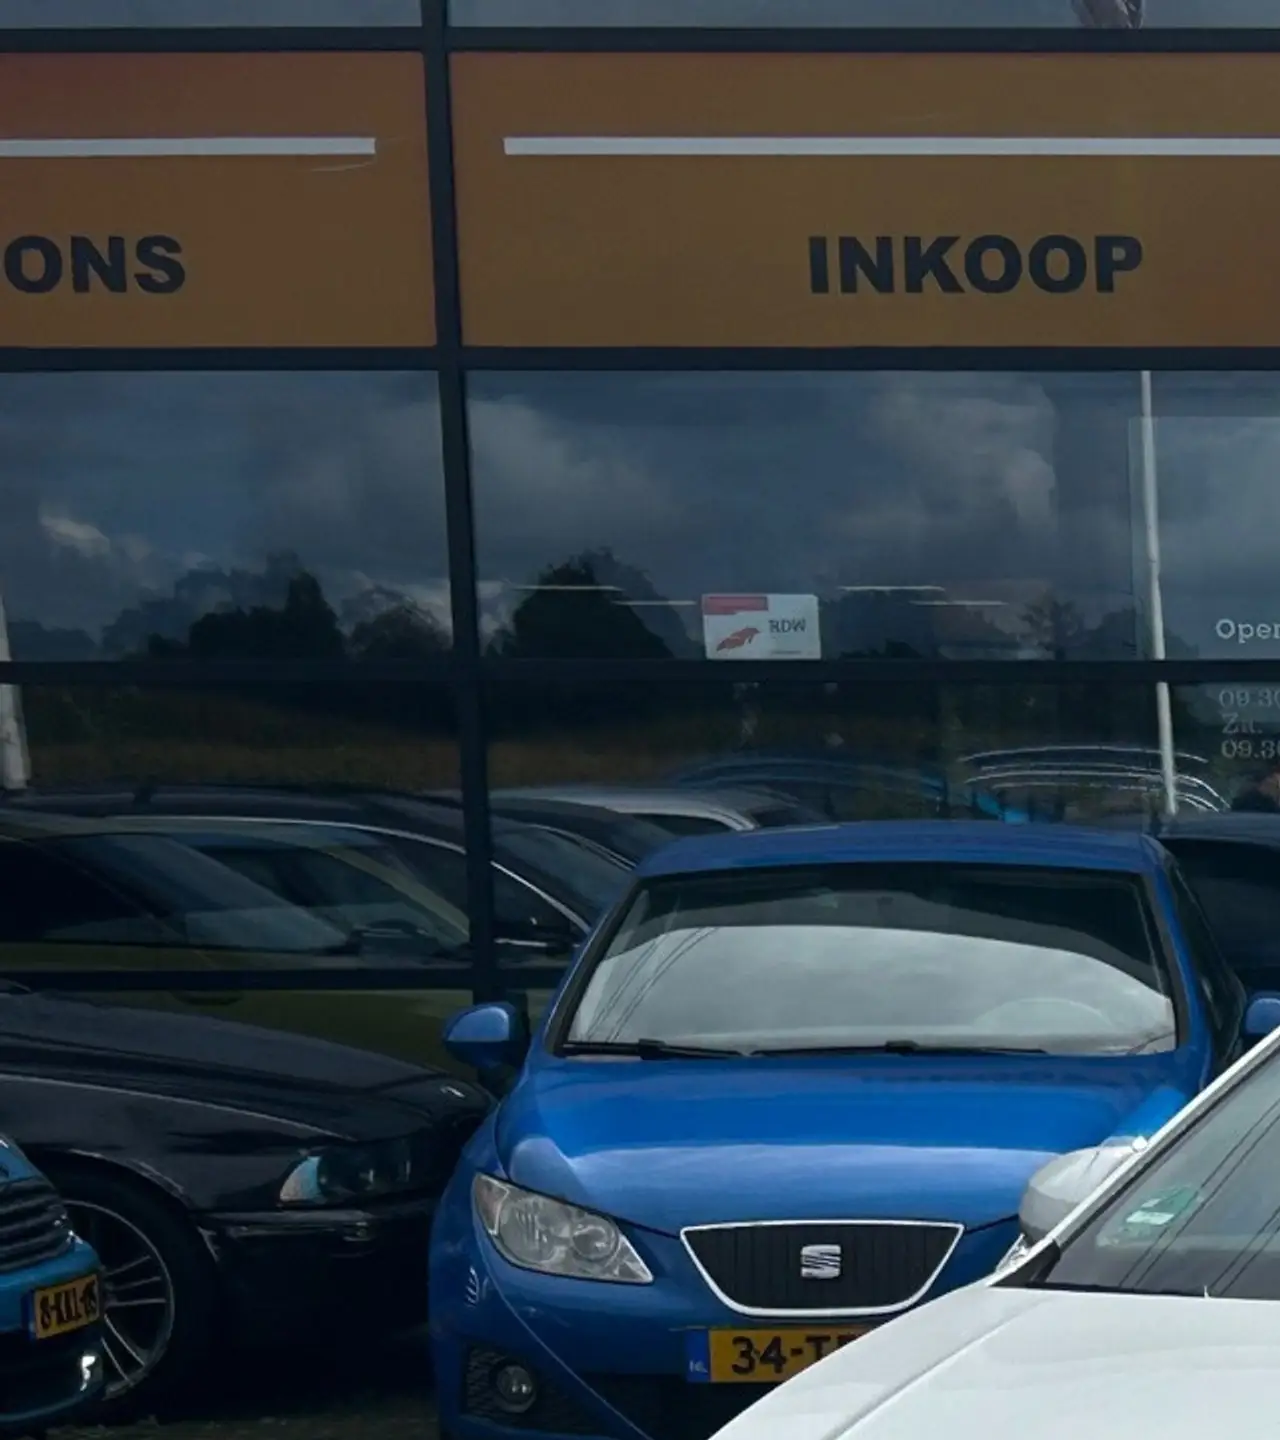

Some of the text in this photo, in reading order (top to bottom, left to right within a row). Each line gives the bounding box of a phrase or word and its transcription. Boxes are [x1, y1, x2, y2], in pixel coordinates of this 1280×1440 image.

[3, 234, 186, 294] ONS
[808, 234, 1143, 293] INKOOP
[768, 618, 807, 634] RDW
